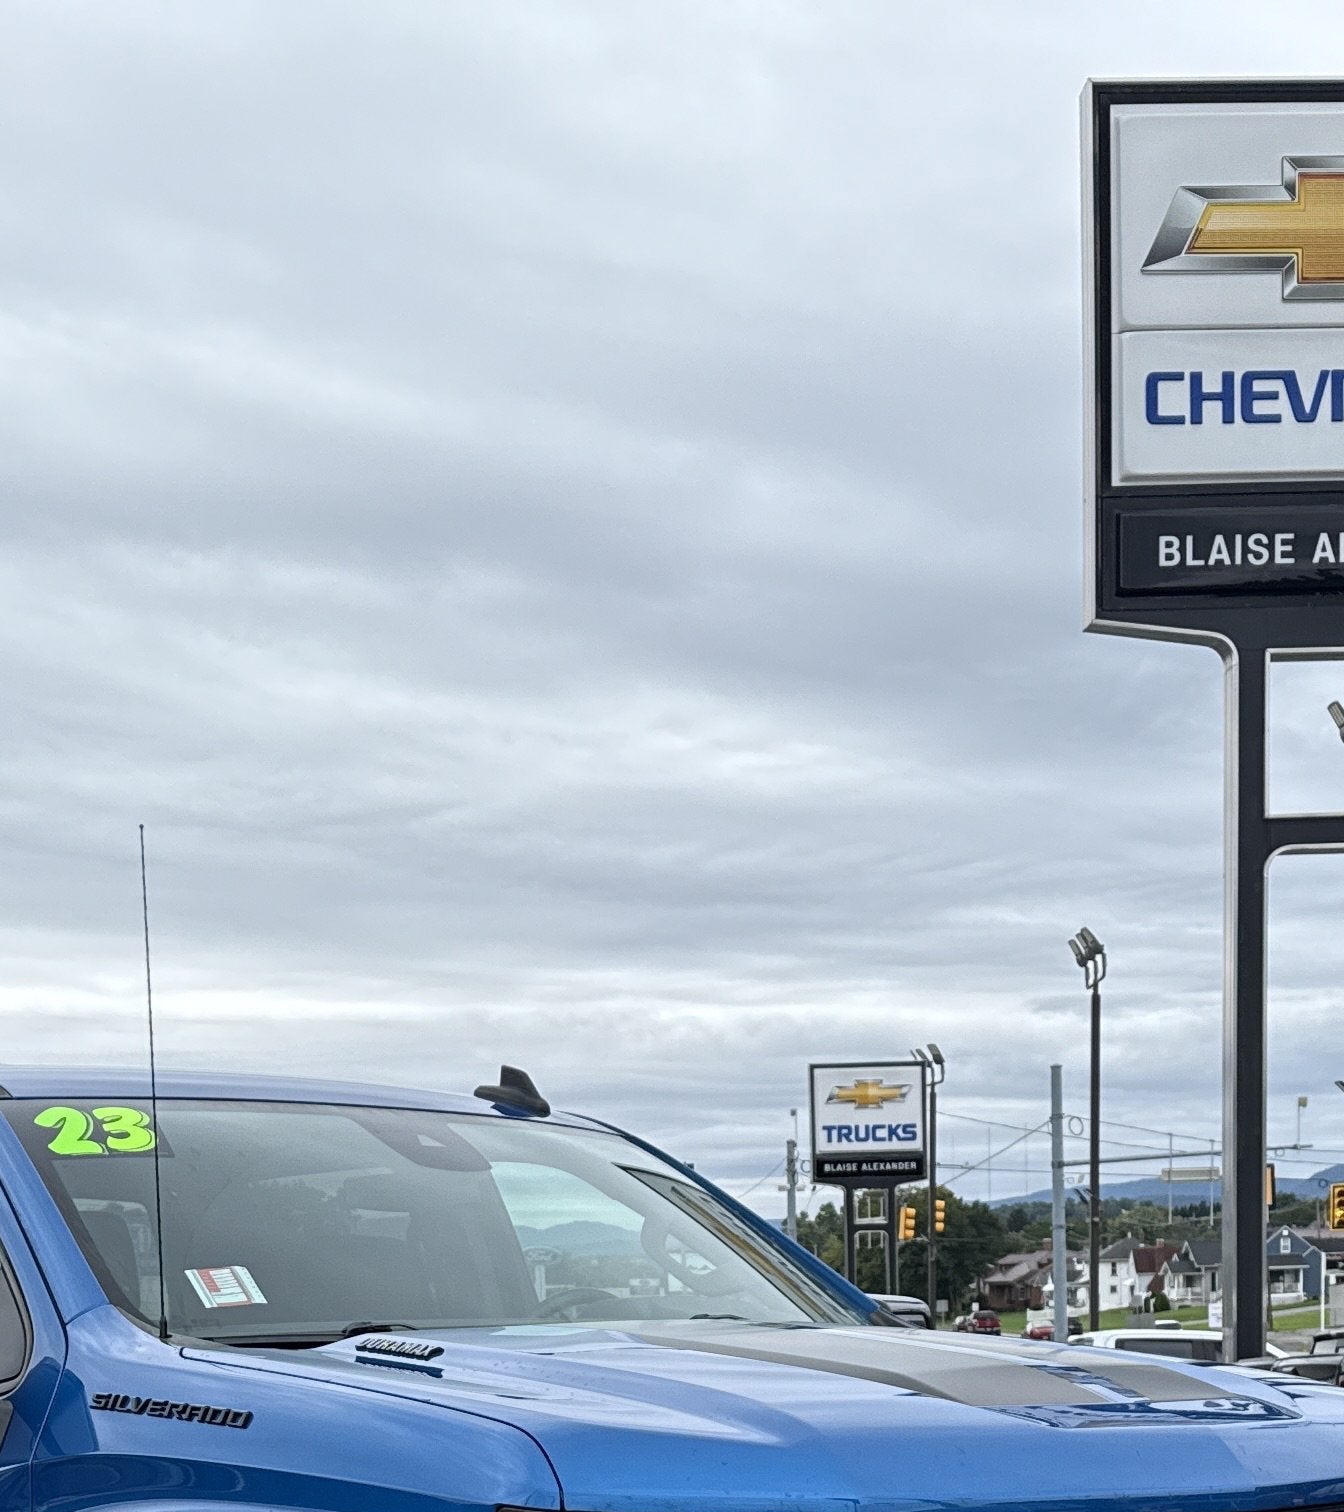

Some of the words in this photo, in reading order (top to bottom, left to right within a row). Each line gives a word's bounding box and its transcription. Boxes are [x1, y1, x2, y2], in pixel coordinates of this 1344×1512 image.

[1158, 532, 1296, 568] BLAISE
[34, 1106, 158, 1156] 23
[822, 1123, 917, 1143] TRUCKS
[824, 1162, 858, 1172] BLAISE
[861, 1161, 917, 1172] ALEXANDER
[89, 1392, 254, 1430] SILVERADO
